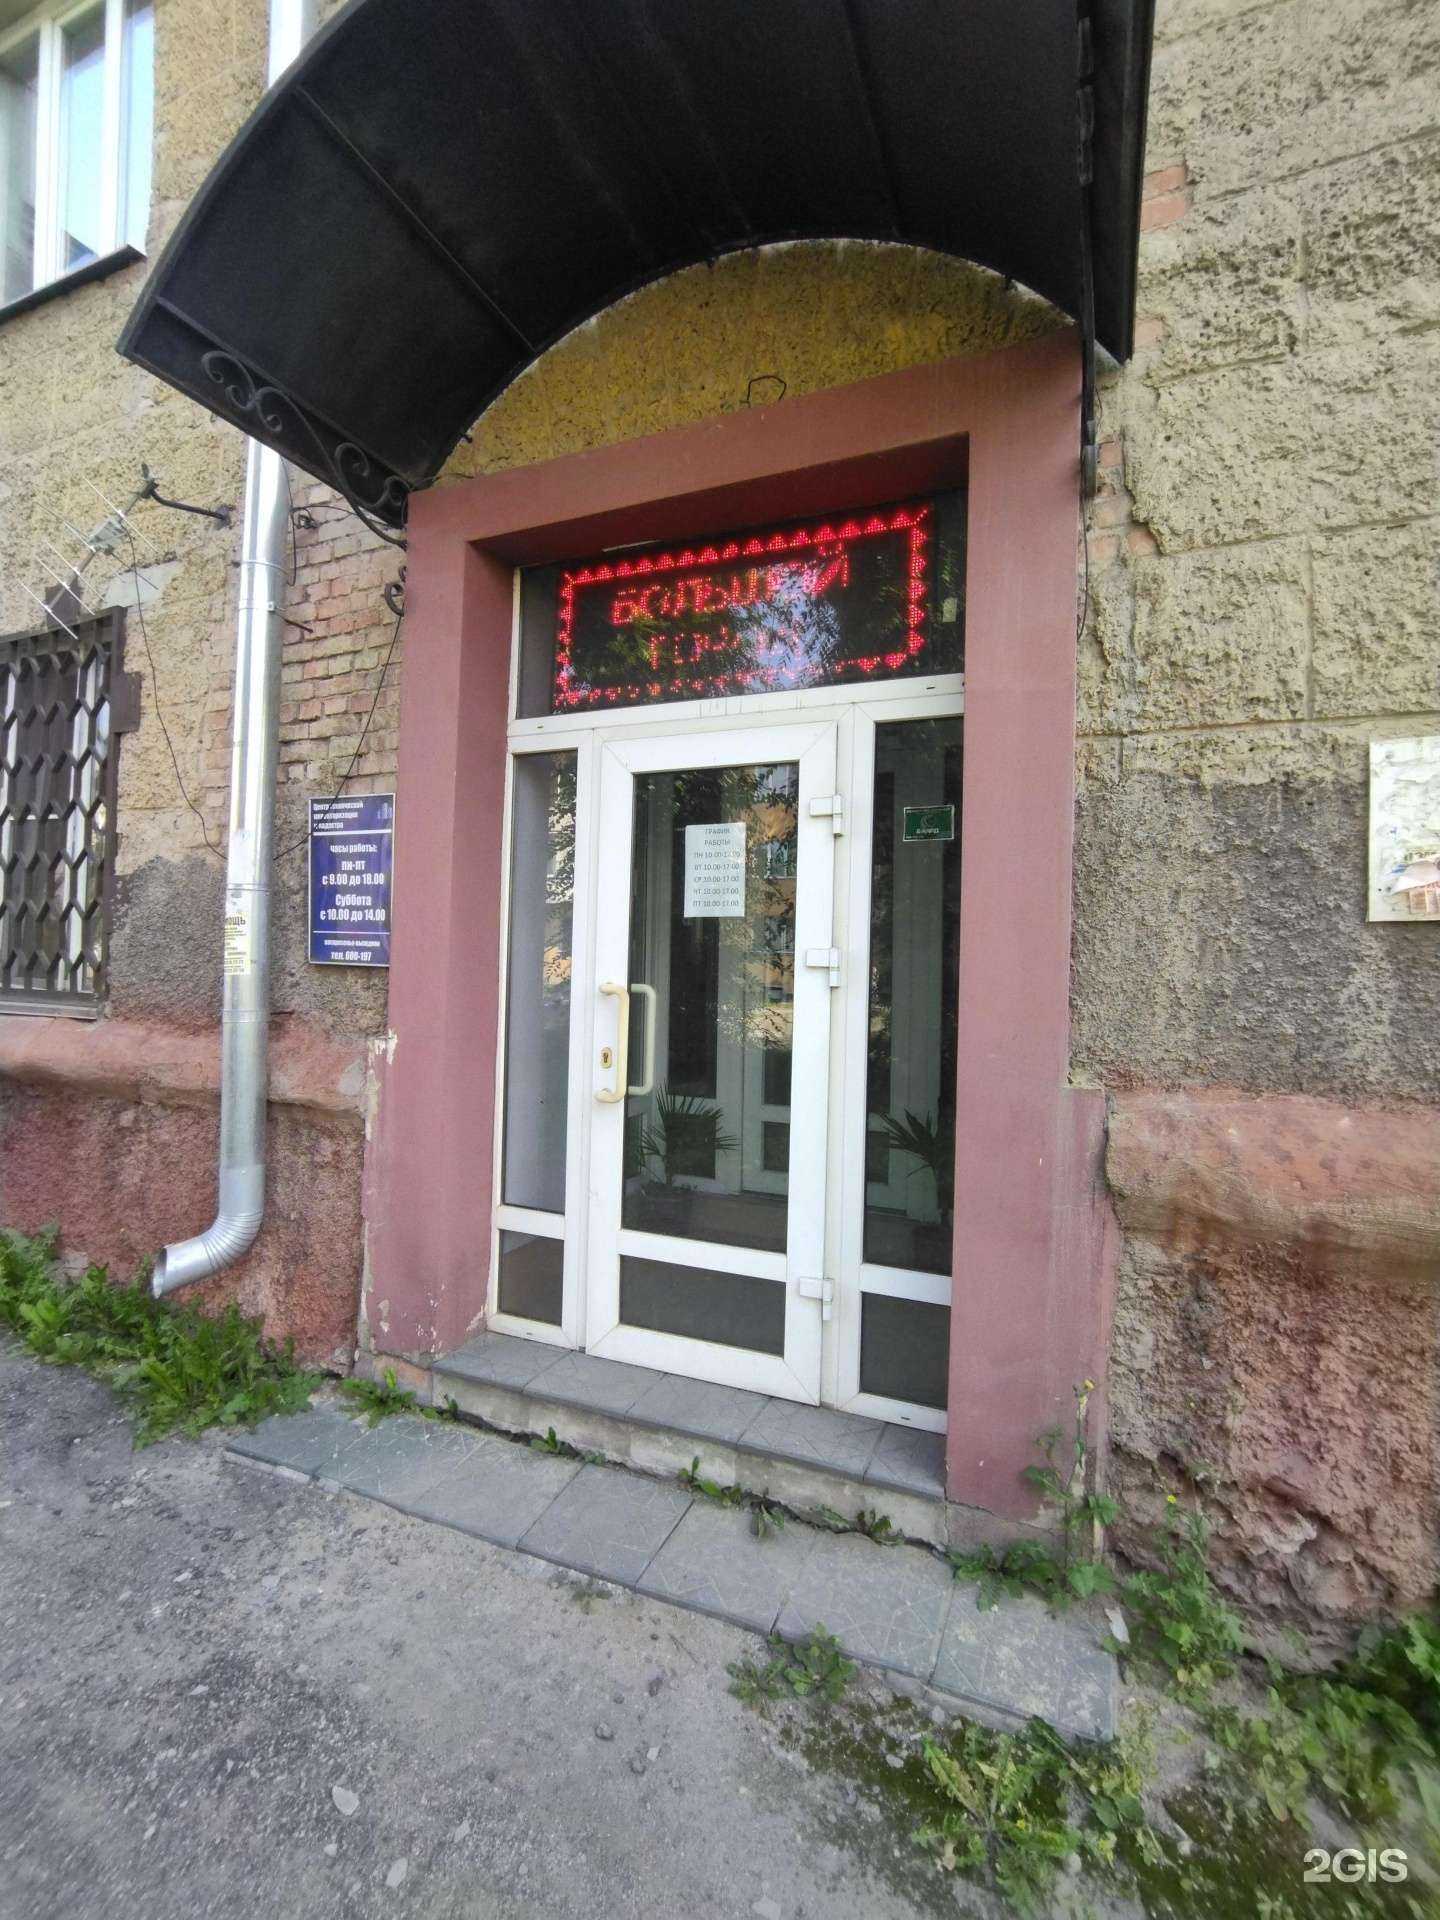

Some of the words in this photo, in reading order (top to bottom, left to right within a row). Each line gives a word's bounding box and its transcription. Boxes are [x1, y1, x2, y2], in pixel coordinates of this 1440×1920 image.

[330, 845, 349, 853] часы
[349, 875, 361, 886] до
[335, 894, 372, 907] Суббота
[326, 908, 349, 920] 10.00
[350, 910, 363, 922] до
[363, 908, 386, 920] 14.00
